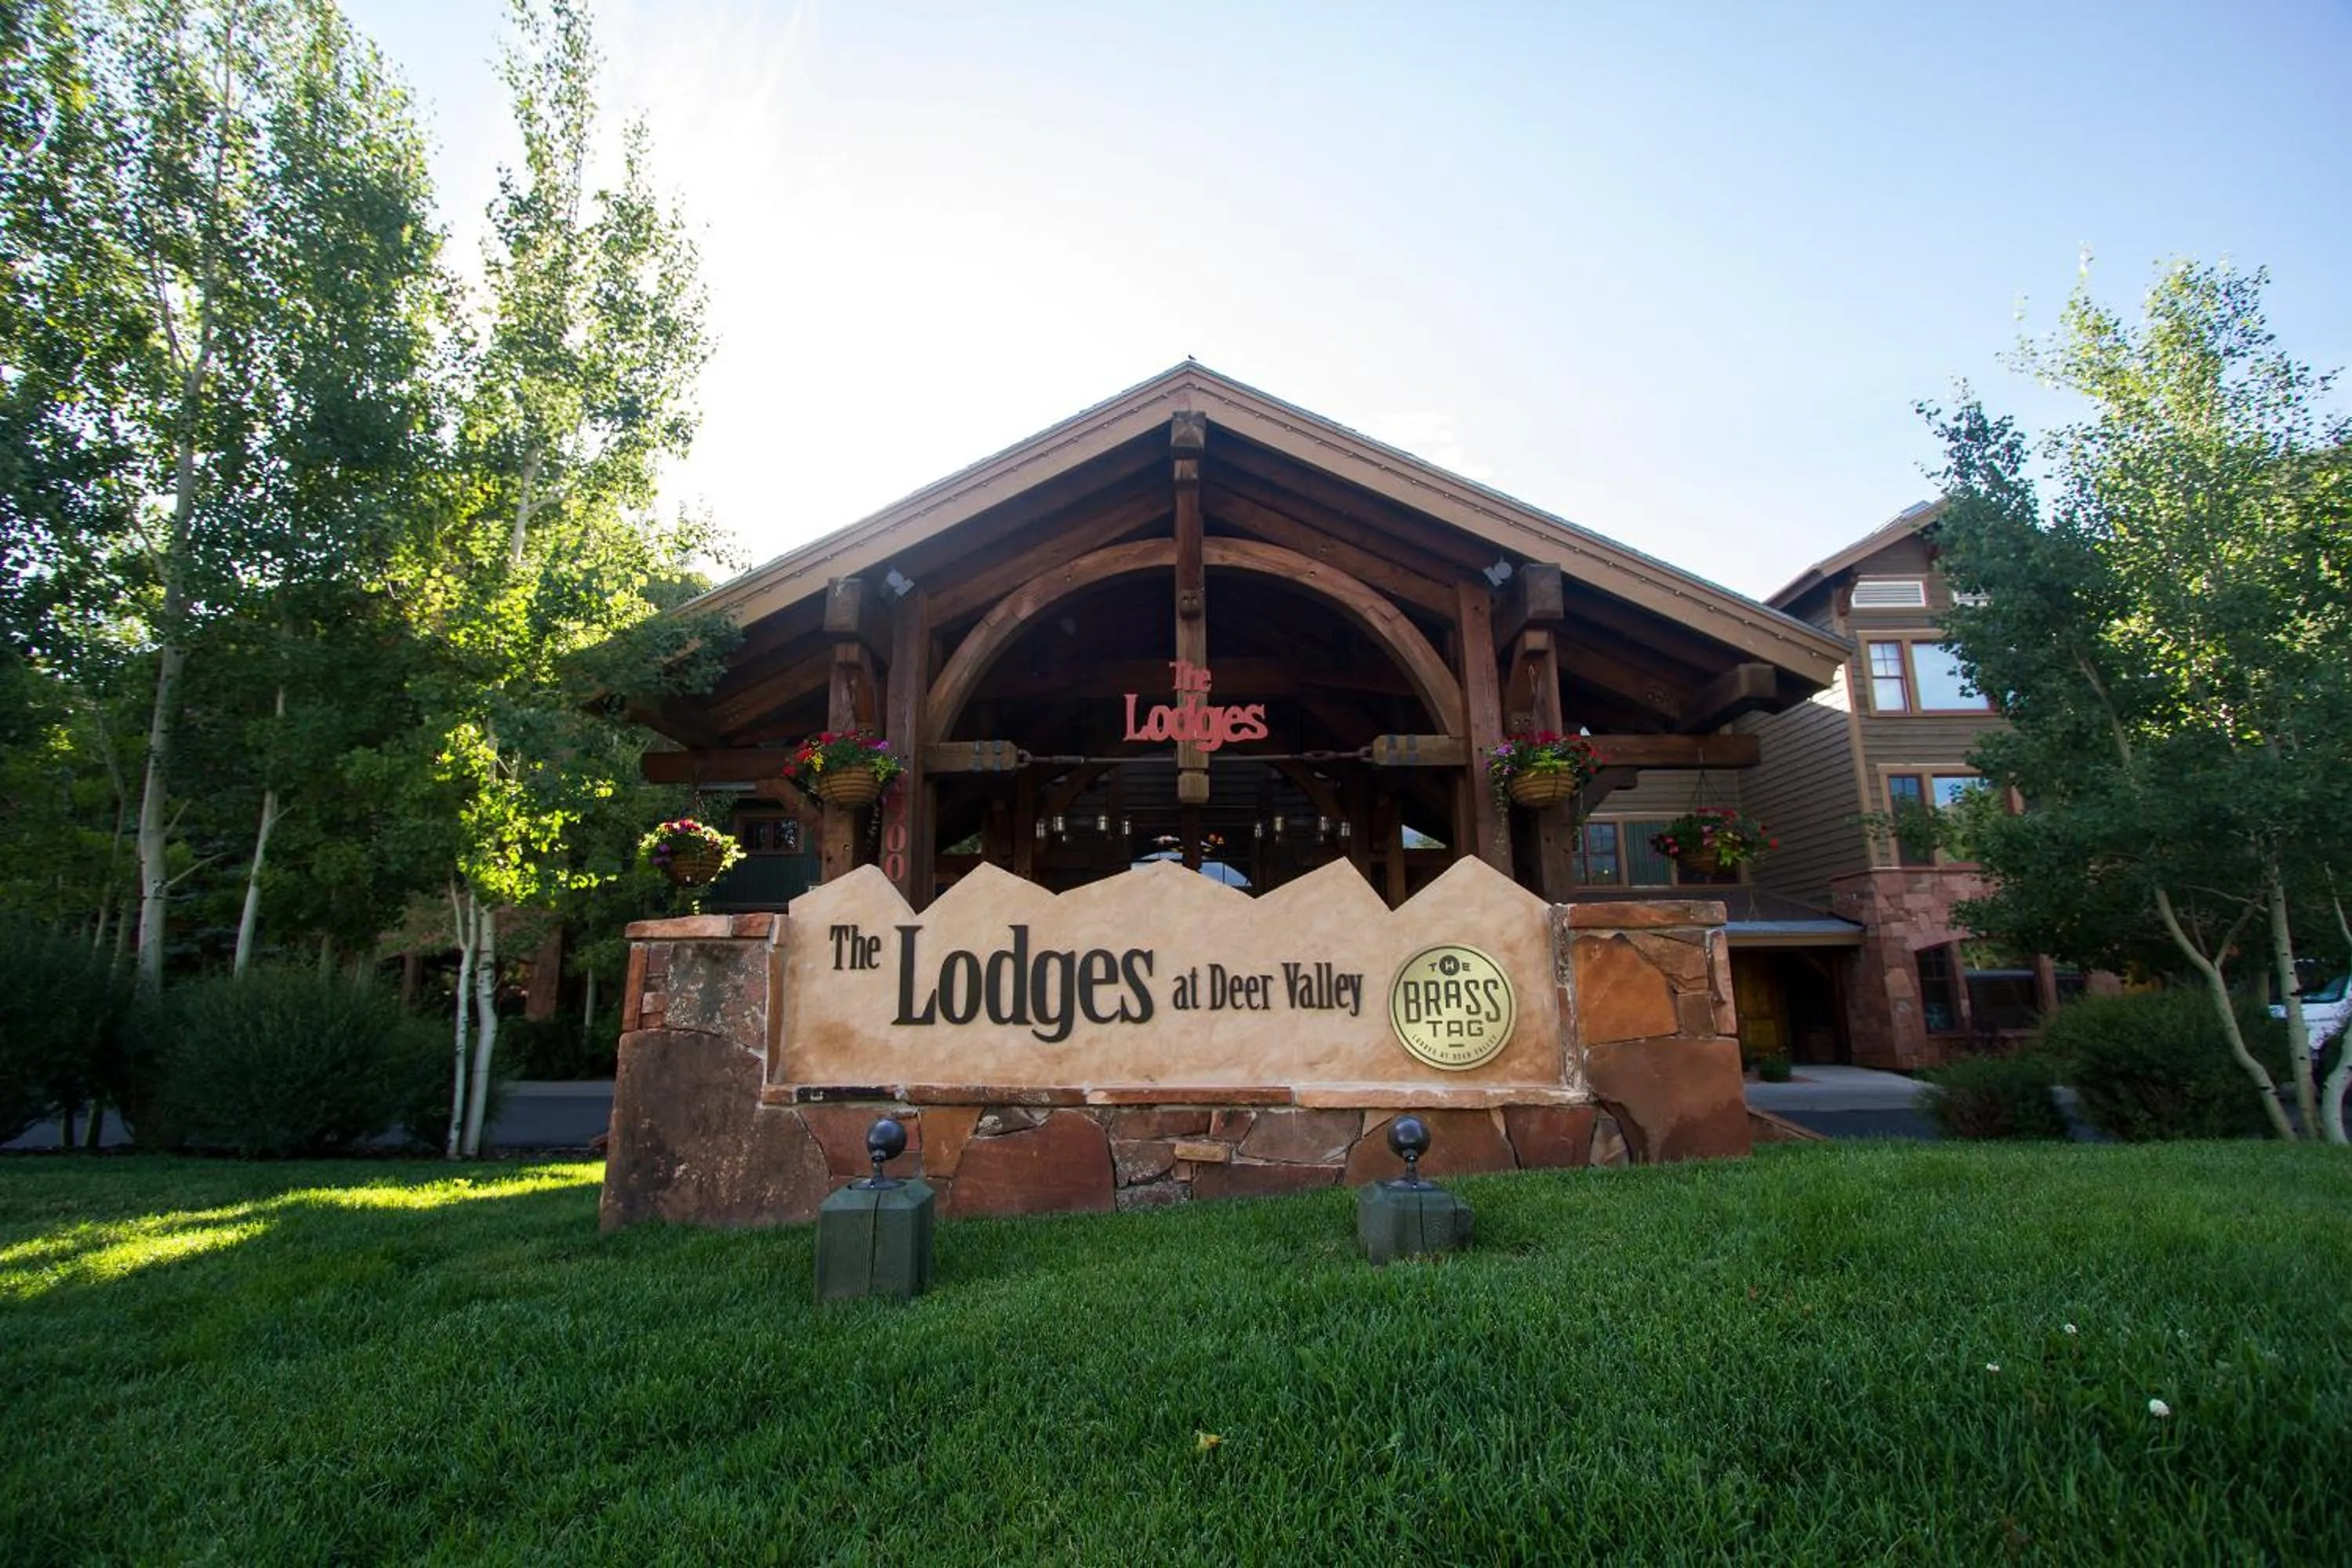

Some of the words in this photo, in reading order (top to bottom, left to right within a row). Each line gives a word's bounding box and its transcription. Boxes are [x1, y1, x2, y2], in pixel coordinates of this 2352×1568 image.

[1169, 661, 1212, 692] The
[1122, 693, 1269, 753] Lodges
[829, 924, 881, 971] The
[891, 924, 1154, 1044] Lodges
[1172, 967, 1201, 1010] at
[1207, 964, 1274, 1011] Deer
[1281, 962, 1364, 1017] Valley
[1428, 958, 1471, 974] THE
[1403, 978, 1501, 1024] BRASS
[1425, 1020, 1484, 1038] TAG
